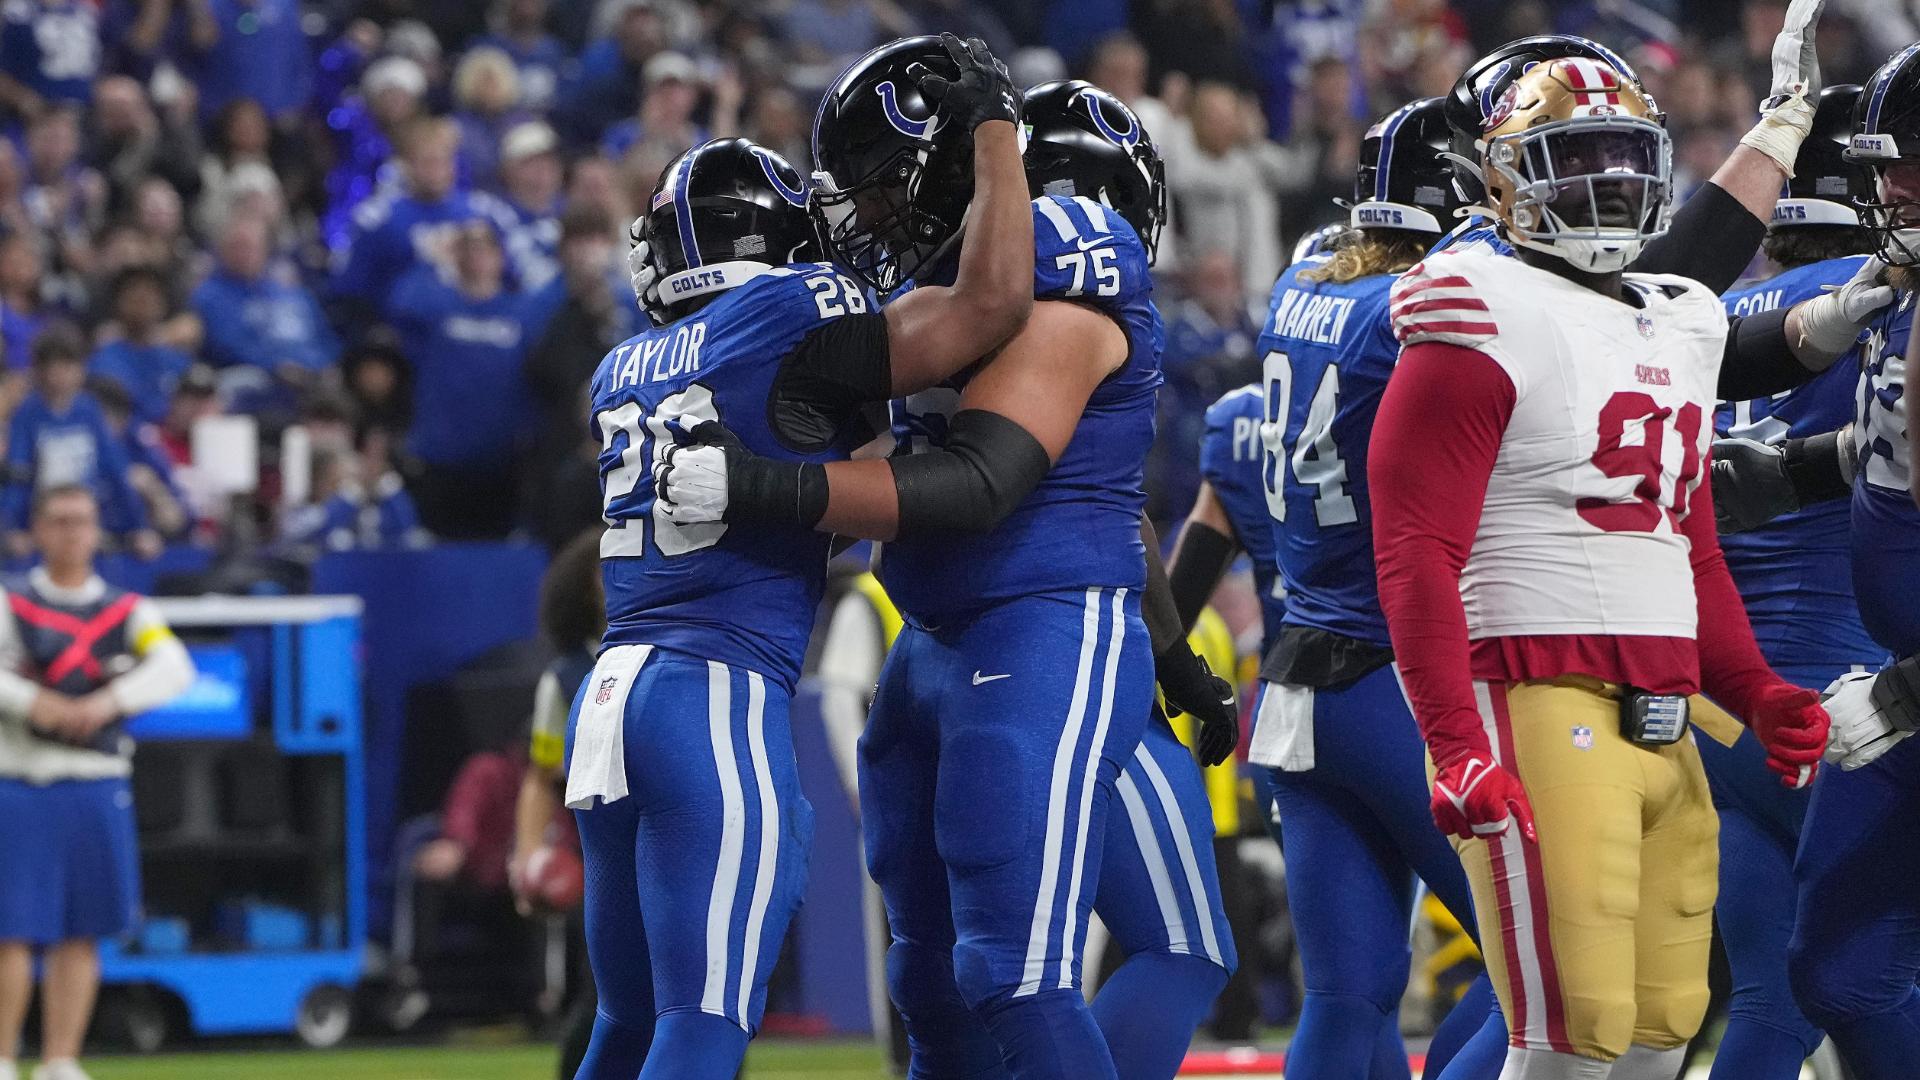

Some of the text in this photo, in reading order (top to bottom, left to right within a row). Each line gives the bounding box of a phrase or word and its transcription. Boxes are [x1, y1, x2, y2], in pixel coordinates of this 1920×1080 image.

[1854, 139, 1882, 150] COLTS
[1358, 209, 1403, 224] COLTS
[671, 270, 726, 294] COLTS
[1055, 248, 1120, 297] 75
[804, 275, 867, 319] 28
[1273, 288, 1357, 344] WARREN
[610, 322, 707, 393] TAYLOR
[1634, 364, 1671, 386] 49ERS
[1260, 351, 1359, 528] 84
[1576, 391, 1704, 535] 91
